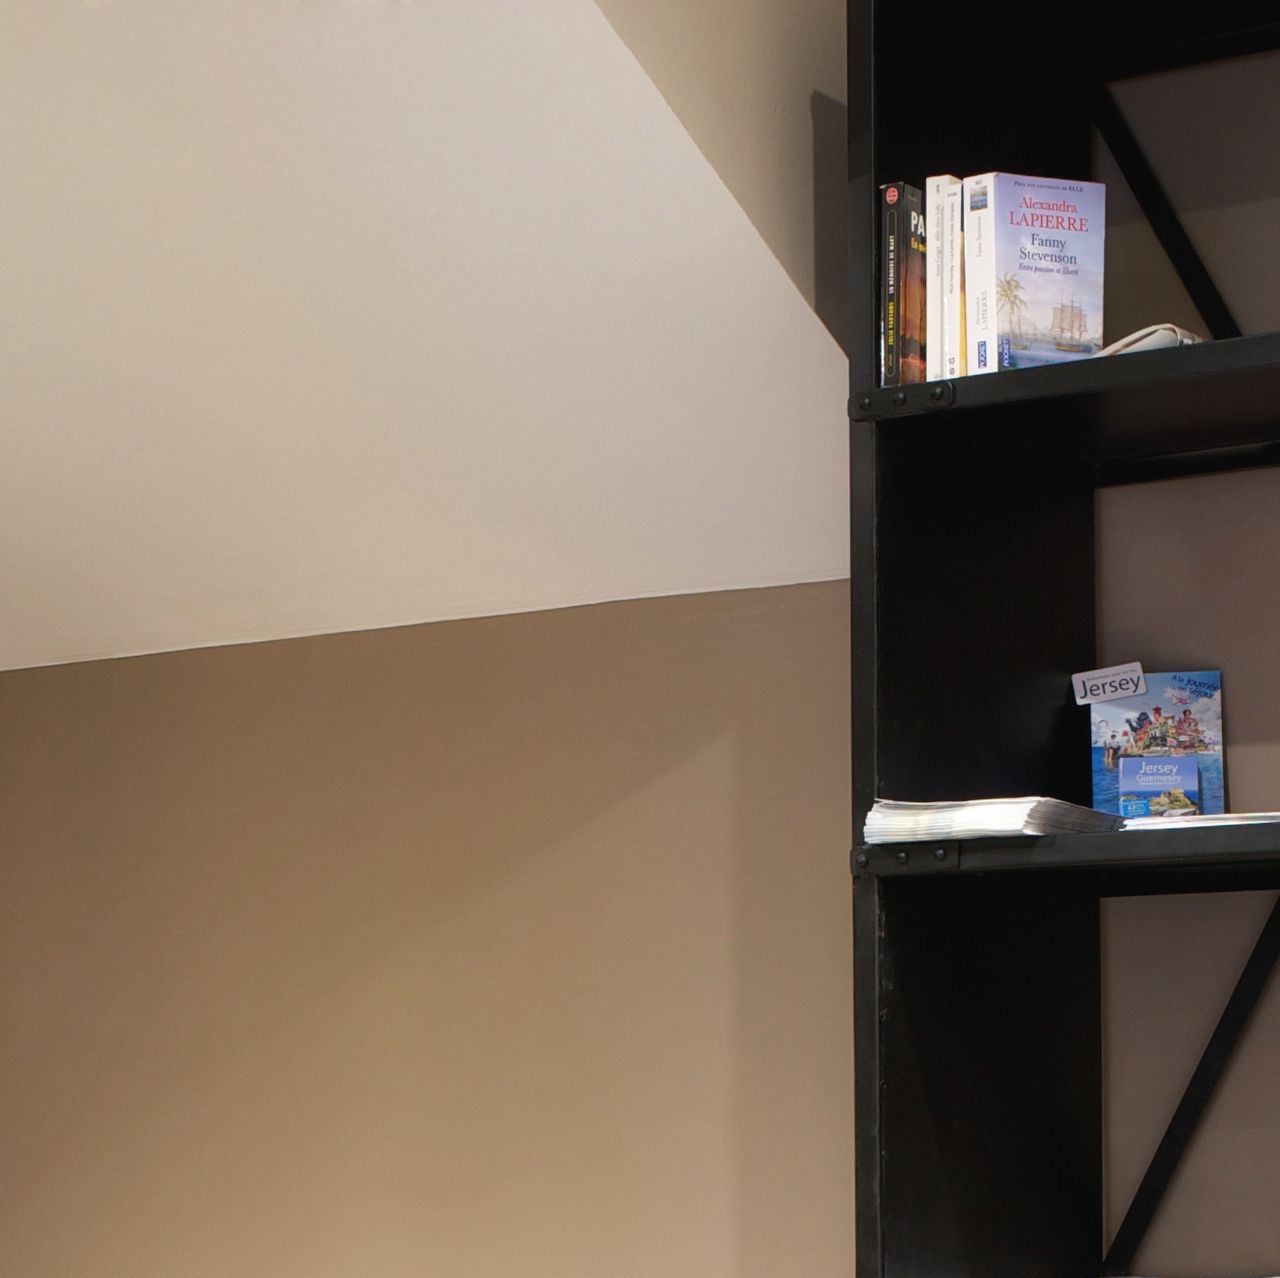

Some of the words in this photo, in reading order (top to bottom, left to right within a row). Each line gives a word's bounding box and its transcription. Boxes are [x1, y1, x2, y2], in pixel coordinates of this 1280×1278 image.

[1019, 196, 1078, 214] Alexandra
[910, 210, 926, 238] PA
[1009, 210, 1089, 232] LAPIERRE
[1031, 233, 1067, 252] Fanny
[1019, 247, 1077, 265] Stevenson
[978, 340, 986, 369] POCKET
[1079, 676, 1141, 700] Jersey
[1138, 761, 1179, 775] Jersey
